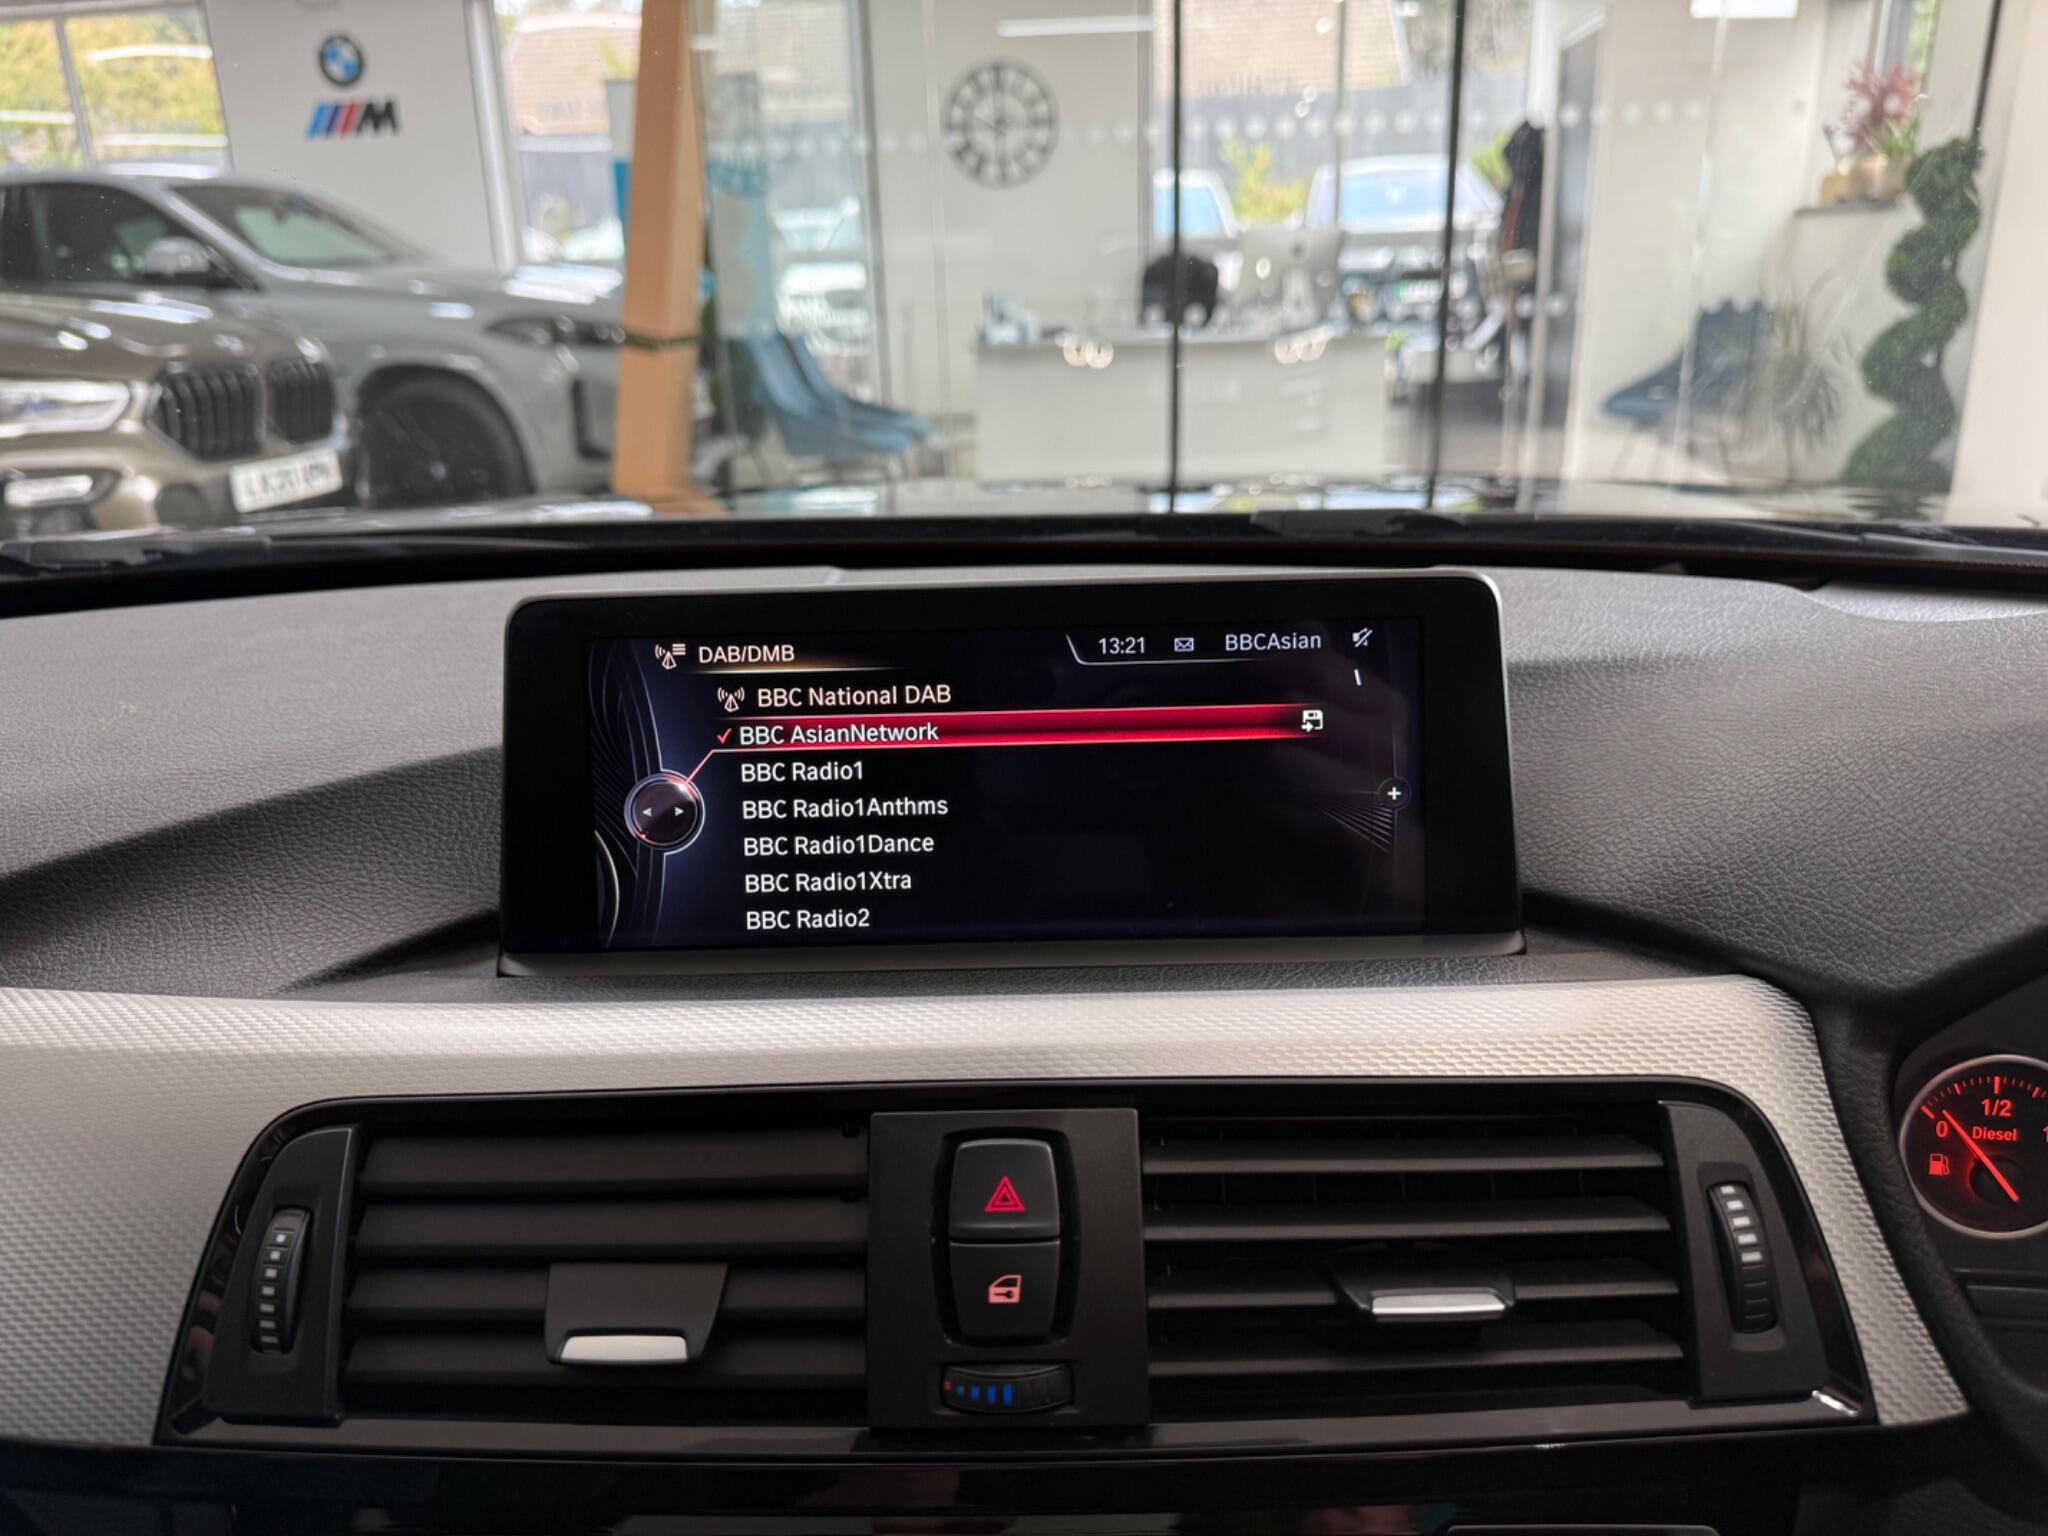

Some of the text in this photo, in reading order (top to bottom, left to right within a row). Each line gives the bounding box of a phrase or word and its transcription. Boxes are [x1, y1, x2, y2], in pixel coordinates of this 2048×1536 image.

[1098, 636, 1145, 655] 13:21
[1225, 632, 1322, 651] BBCAsian
[698, 644, 795, 664] DAB/DMB
[757, 684, 952, 708] BBC National DAB
[739, 722, 939, 746] BBC AsianNetwork
[740, 760, 863, 783] BBC Radio1
[742, 796, 949, 820] BBC Radio1Anthms
[743, 834, 935, 857] BBC Radio1Dance
[745, 870, 912, 894] BBC Radio1Xtra
[746, 908, 870, 931] BBC Radio2
[1981, 1099, 2013, 1117] 1/2
[1935, 1120, 1949, 1138] 0
[1971, 1126, 2018, 1141] Diesel
